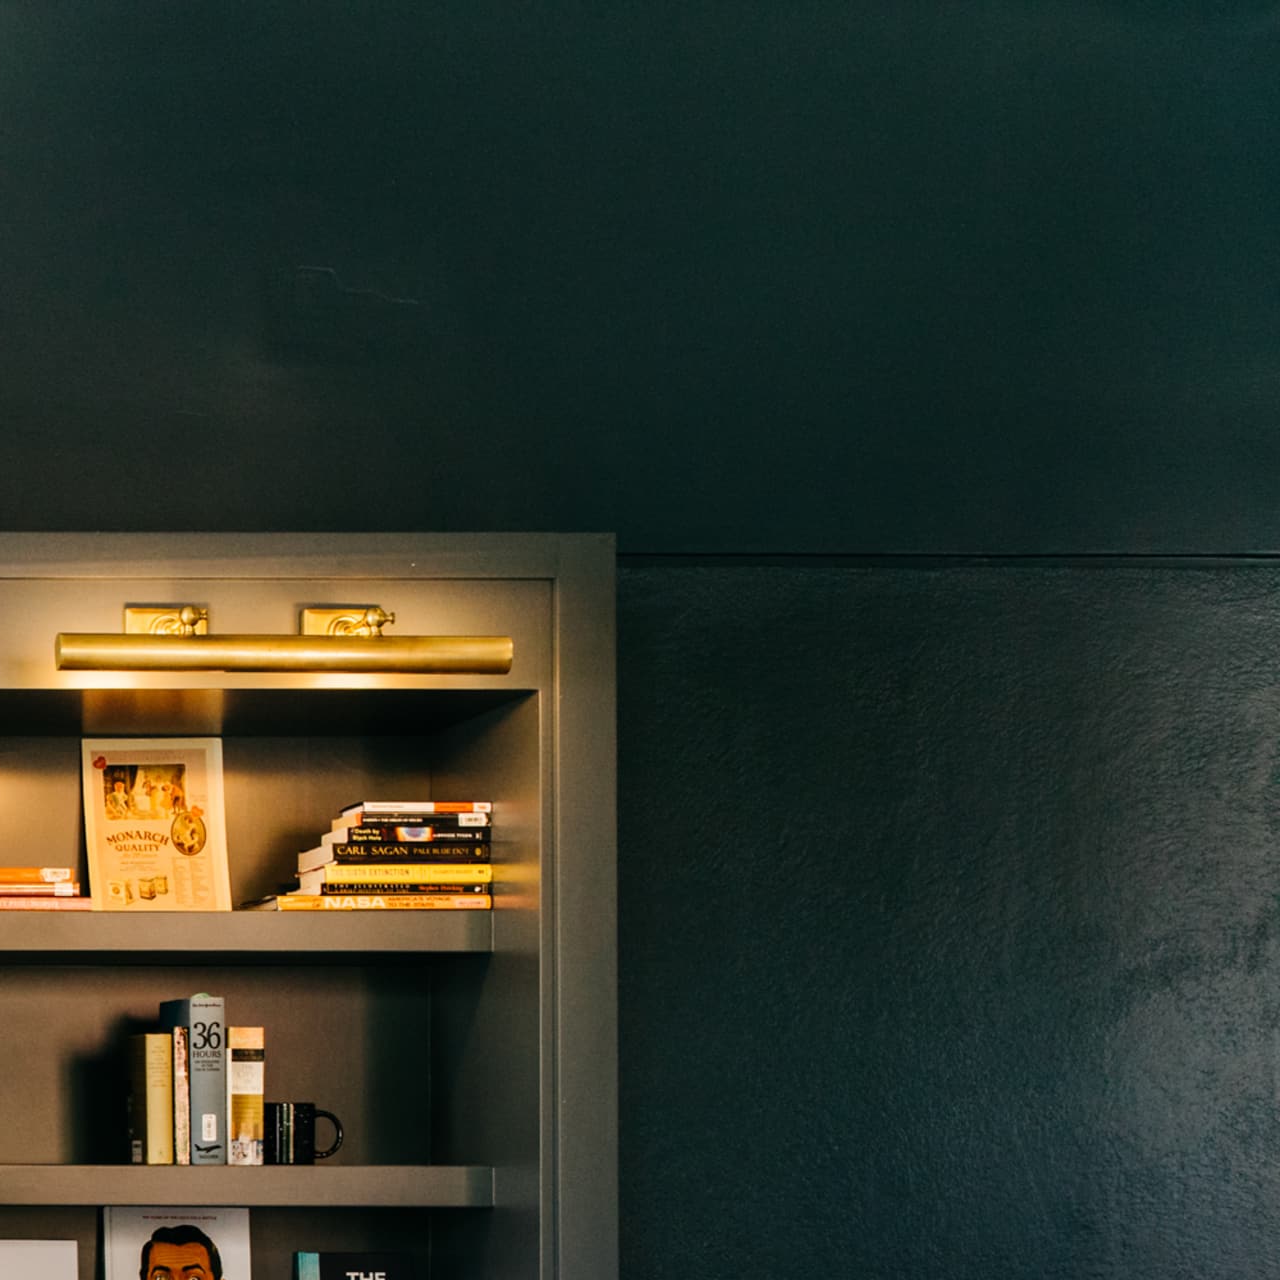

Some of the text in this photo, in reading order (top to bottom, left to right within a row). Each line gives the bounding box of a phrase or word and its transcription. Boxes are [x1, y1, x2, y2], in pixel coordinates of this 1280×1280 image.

[106, 830, 169, 846] MONARCH
[115, 844, 159, 852] QUALITY
[337, 846, 367, 855] CARL
[371, 846, 408, 855] SAGAN
[324, 897, 386, 909] NASA
[192, 1021, 221, 1050] 36
[192, 1050, 222, 1058] HOURS
